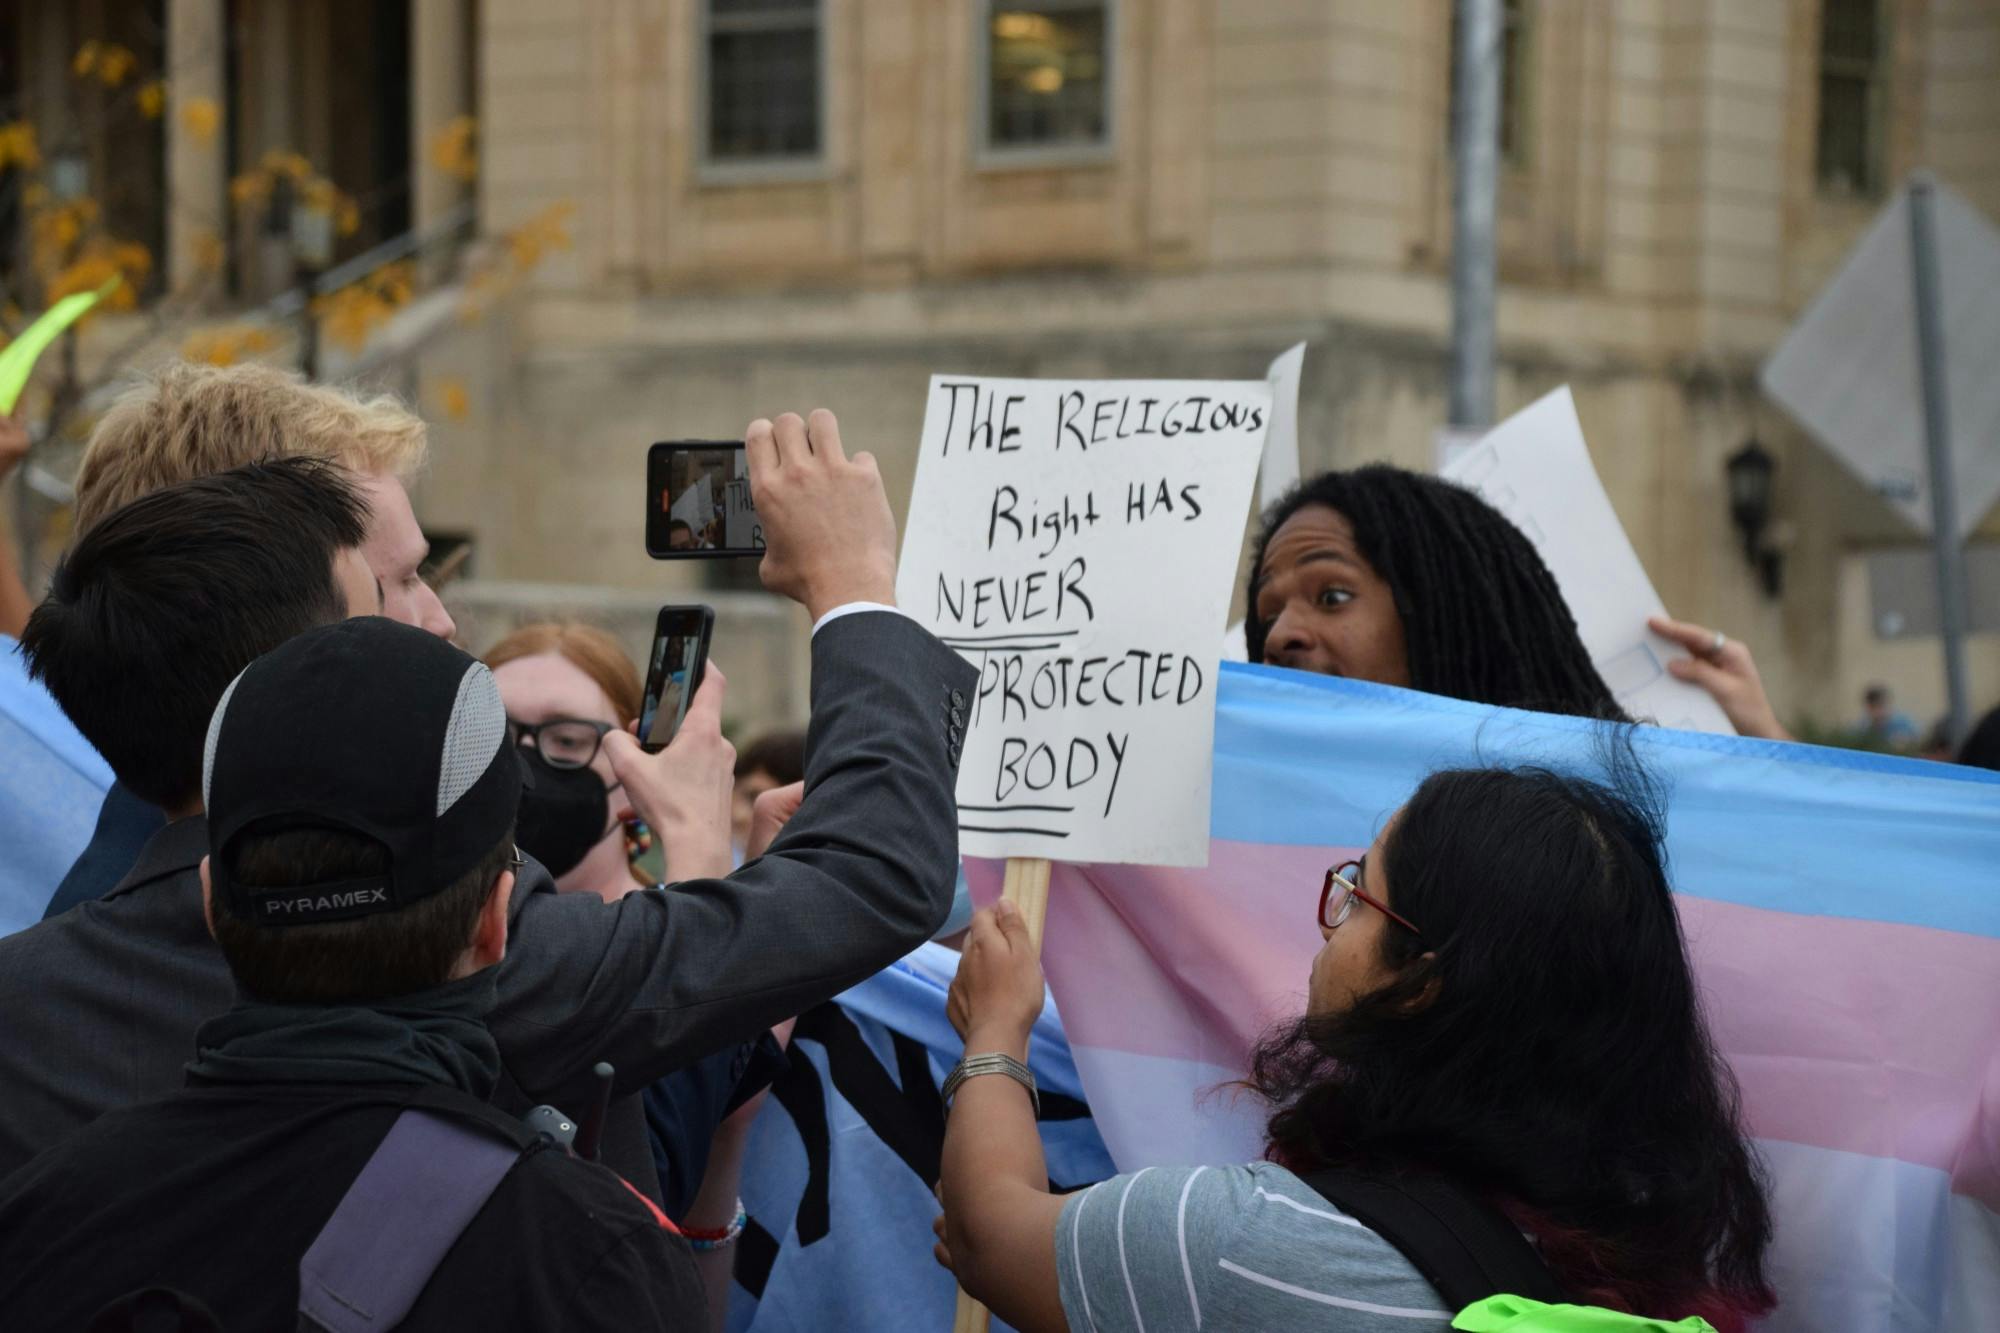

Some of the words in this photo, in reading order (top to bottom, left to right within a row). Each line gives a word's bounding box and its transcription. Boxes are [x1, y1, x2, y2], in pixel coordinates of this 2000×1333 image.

[939, 383, 1026, 457] THE
[1055, 390, 1264, 451] RELIGIOUS
[987, 485, 1101, 559] Right
[1126, 478, 1203, 525] HAS
[936, 556, 1095, 630] NEVER
[974, 649, 1204, 728] PROTECTED
[995, 732, 1130, 819] BODY
[265, 887, 388, 915] PYRAMEX
